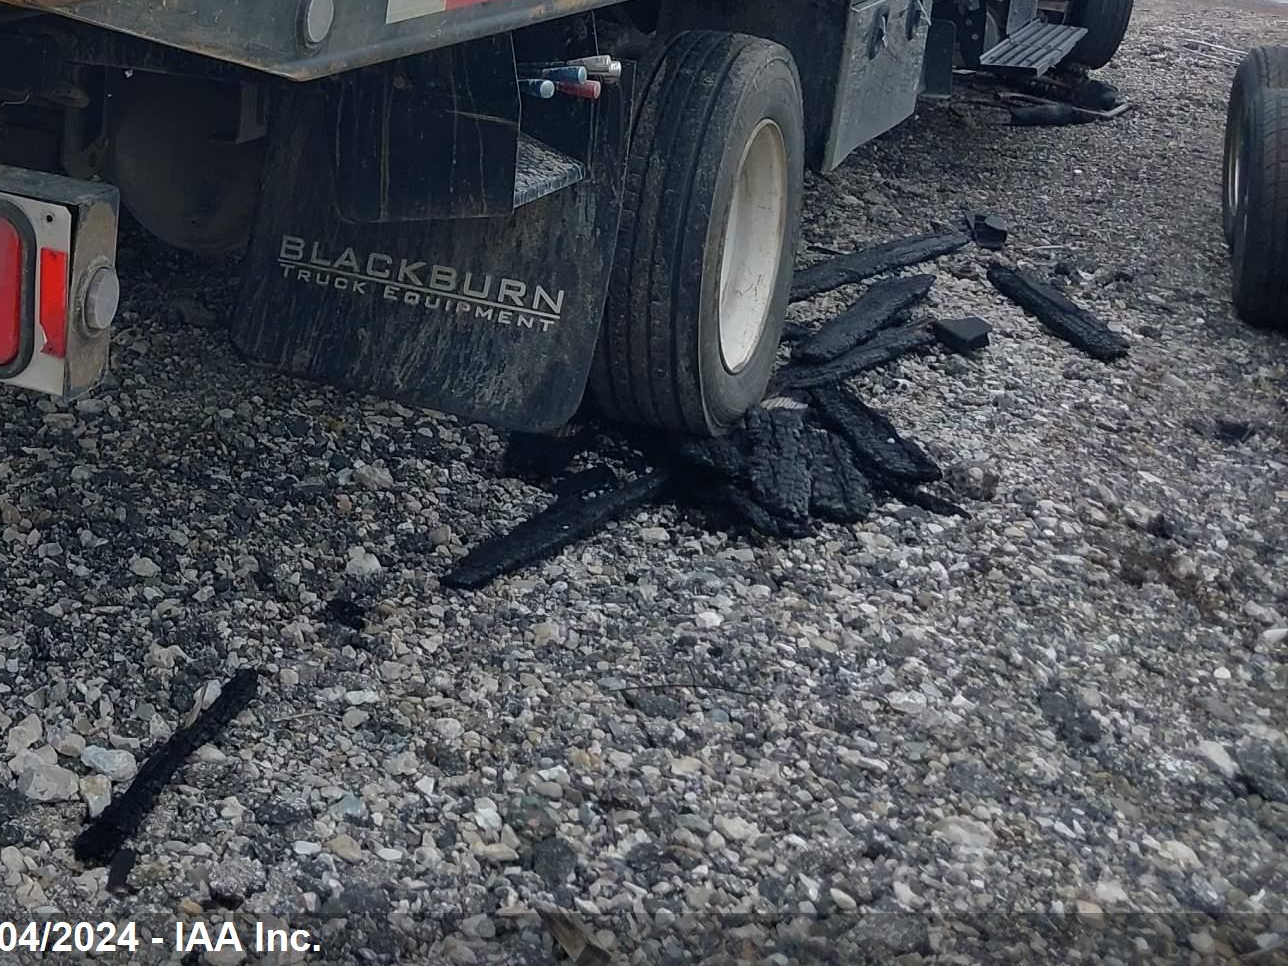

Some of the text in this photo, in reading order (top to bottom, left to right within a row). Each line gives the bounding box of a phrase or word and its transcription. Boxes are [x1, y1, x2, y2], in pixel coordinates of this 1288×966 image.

[278, 234, 565, 315] BLACKBURN
[280, 263, 556, 333] TRUCK EQUIPMENT
